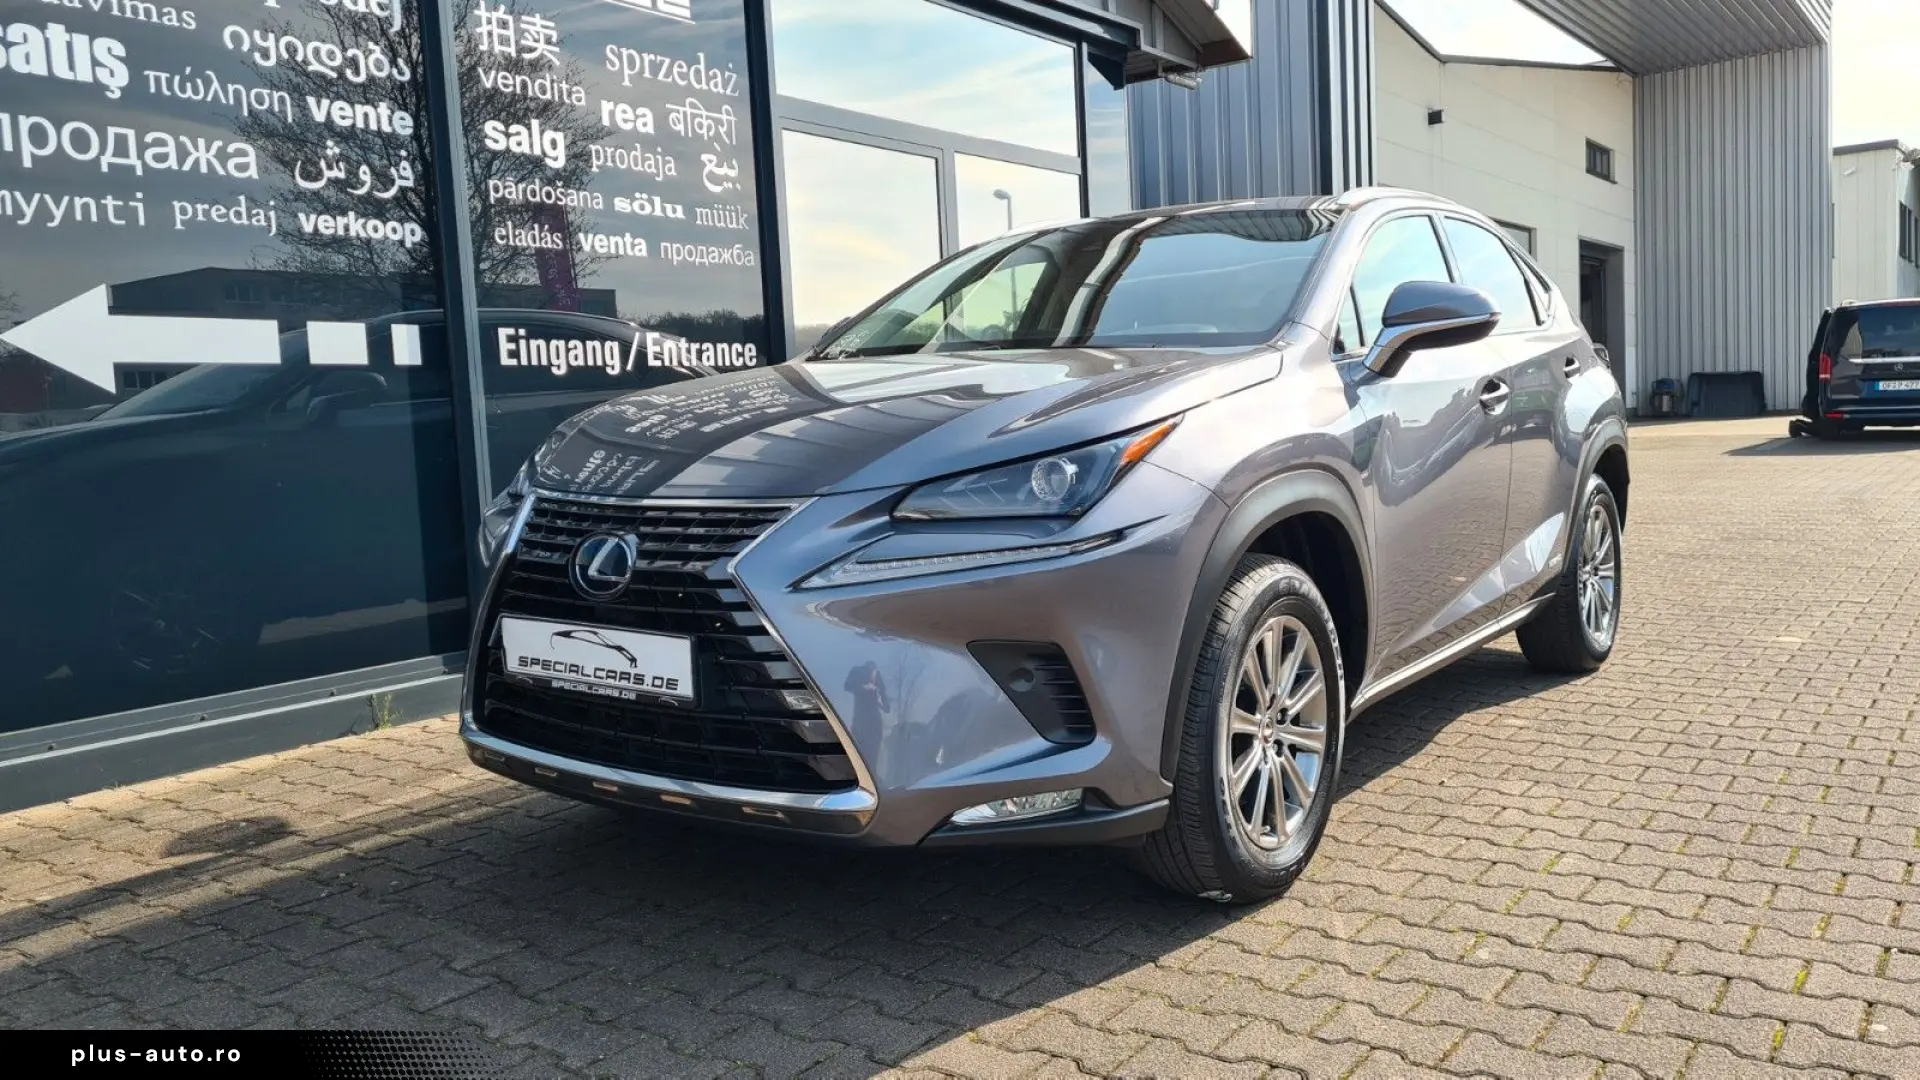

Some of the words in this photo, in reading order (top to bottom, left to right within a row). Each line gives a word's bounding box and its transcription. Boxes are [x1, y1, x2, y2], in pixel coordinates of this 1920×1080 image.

[474, 0, 560, 66] 拍卖
[0, 22, 130, 99] atış
[605, 44, 739, 97] sprzedaż
[144, 66, 293, 122] πώληση
[477, 66, 586, 106] vendita
[306, 95, 414, 135] vente
[600, 99, 655, 134] rea
[484, 119, 565, 168] salg
[589, 143, 677, 181] prodaja
[172, 195, 277, 236] predaj
[489, 177, 604, 210] pārdošana
[613, 192, 686, 219] sölu
[695, 204, 749, 229] müük
[298, 211, 422, 247] verkoop
[494, 221, 563, 249] eladás
[578, 232, 648, 257] venta
[660, 241, 755, 266] продажба
[497, 327, 620, 375] Eingang
[646, 331, 757, 367] Entrance
[518, 655, 679, 691] SPECIALCARS.DE
